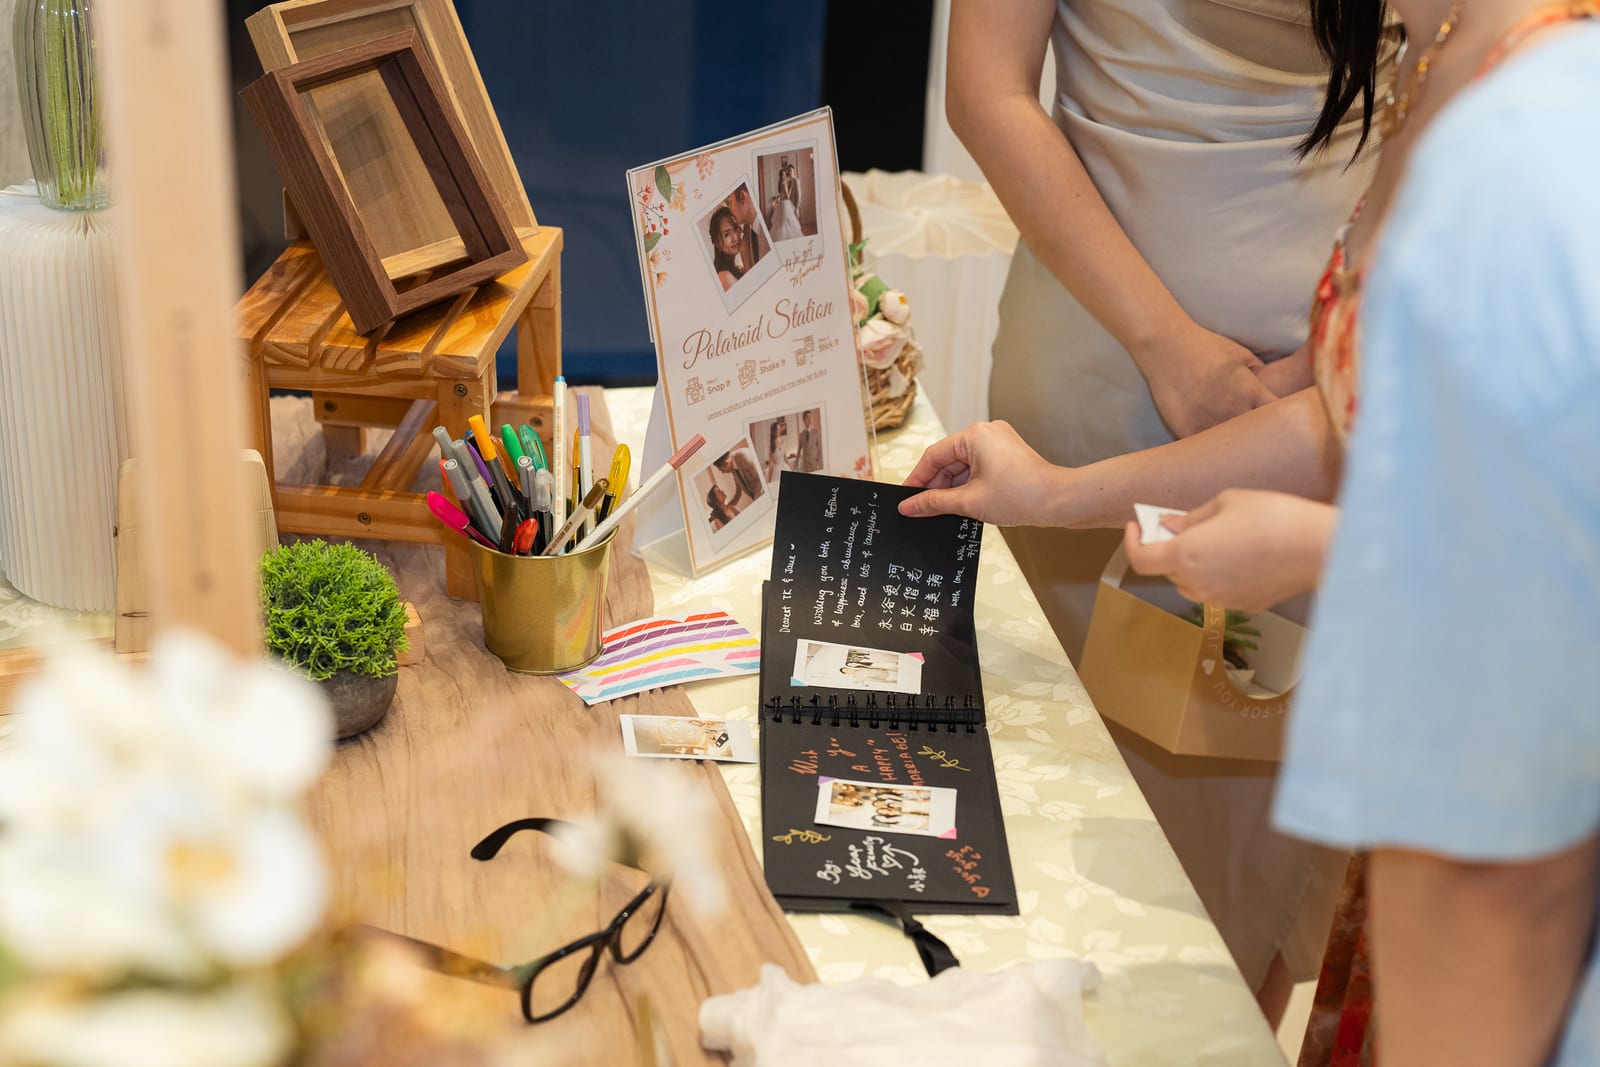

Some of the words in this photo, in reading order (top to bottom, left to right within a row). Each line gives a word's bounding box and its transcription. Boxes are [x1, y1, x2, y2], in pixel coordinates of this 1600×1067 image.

[682, 314, 764, 370] Polaroid
[766, 298, 833, 340] Station
[759, 361, 780, 375] Shake
[707, 383, 725, 395] Snap
[824, 487, 840, 518] lifetime
[818, 540, 831, 558] both
[841, 521, 859, 570] abundance
[820, 565, 834, 582] you
[859, 564, 871, 578] lots
[782, 588, 792, 601] TK
[857, 587, 868, 607] and
[951, 589, 962, 607] With
[813, 589, 834, 625] Wishing
[779, 605, 792, 633] Dearest
[1207, 606, 1222, 650] JUST
[1214, 681, 1238, 711] YOU
[1240, 706, 1270, 719] FOR
[787, 749, 819, 775] Wish
[851, 764, 873, 773] A
